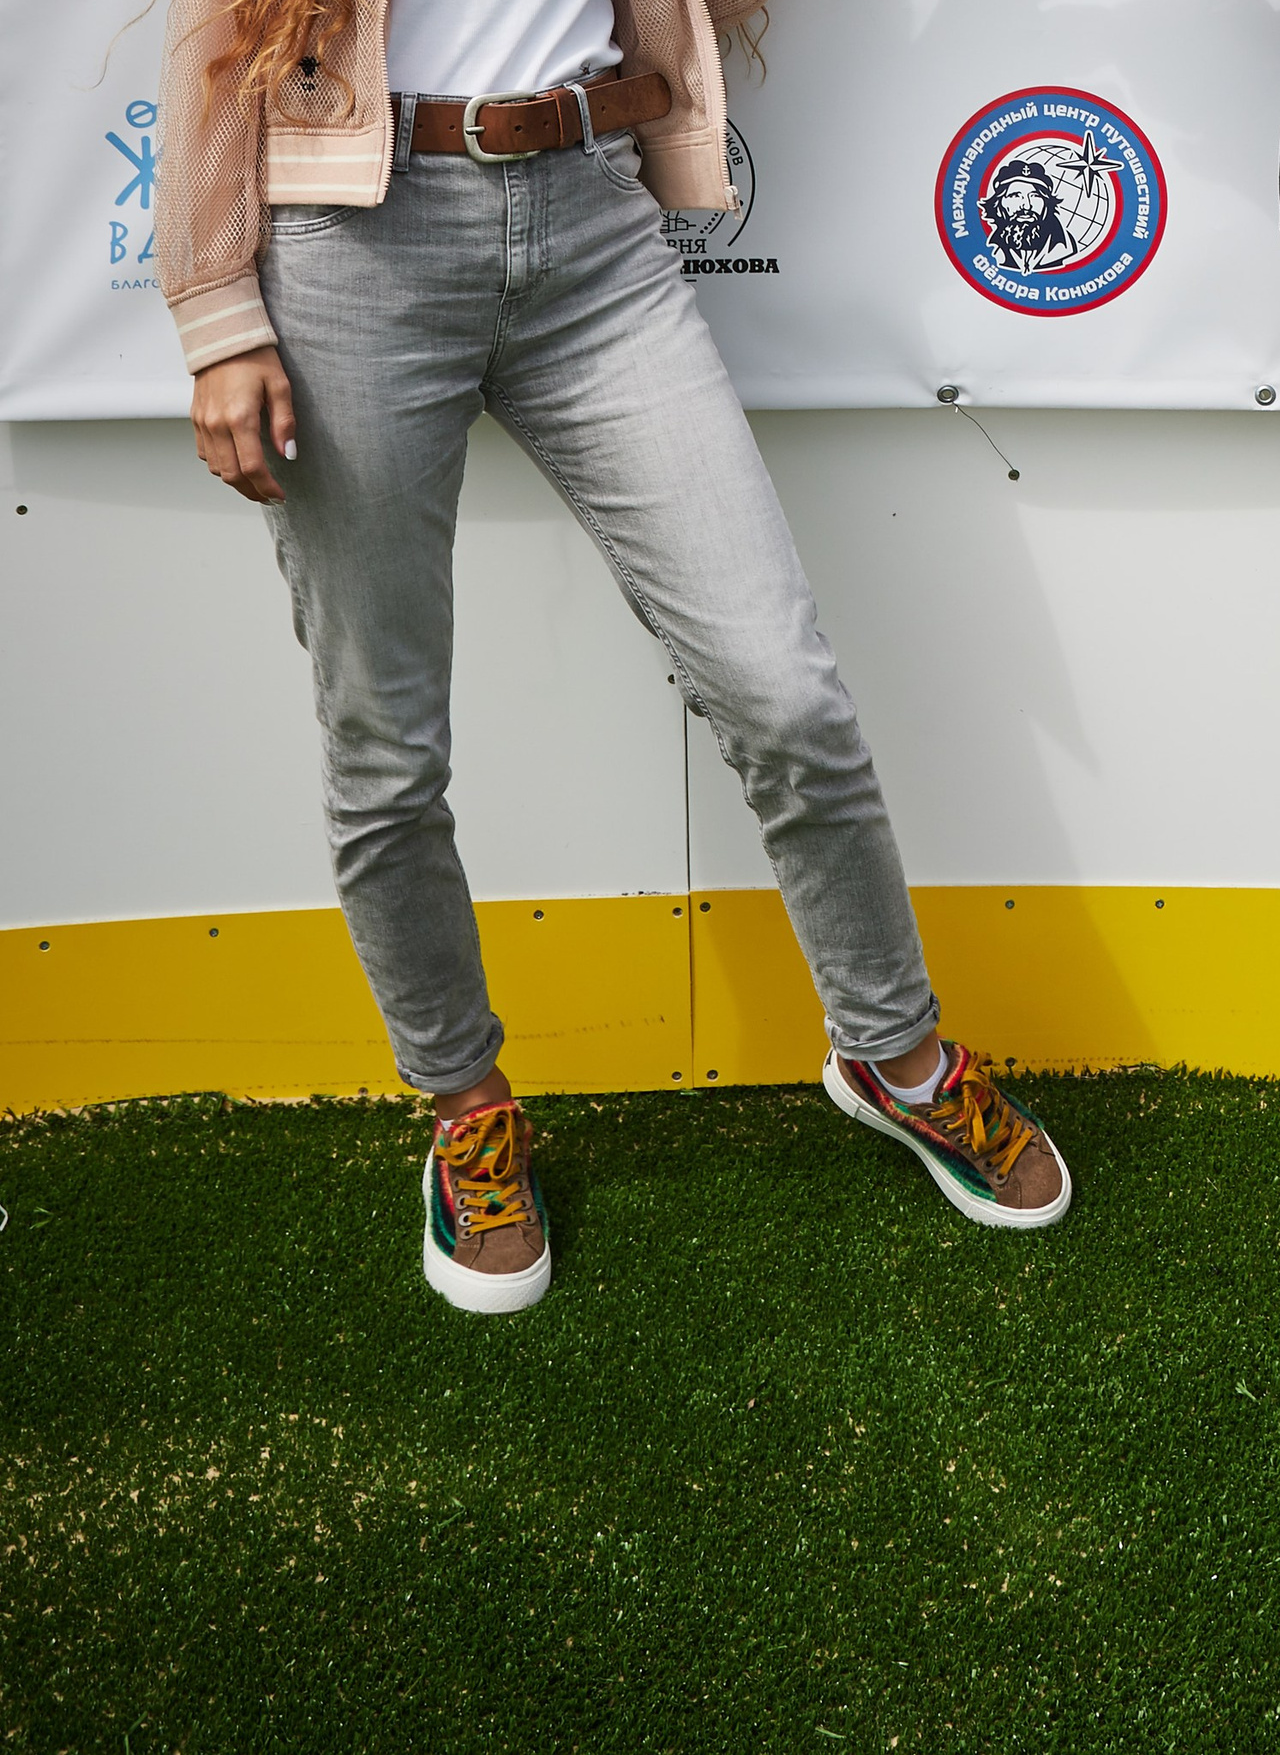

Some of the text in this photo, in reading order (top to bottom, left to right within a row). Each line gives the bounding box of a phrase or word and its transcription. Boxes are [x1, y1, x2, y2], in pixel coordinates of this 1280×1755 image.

[950, 101, 1151, 241] Международный центр путешествий
[679, 257, 781, 275] НЮХОВА
[971, 251, 1135, 302] Фёдора Конюхова
